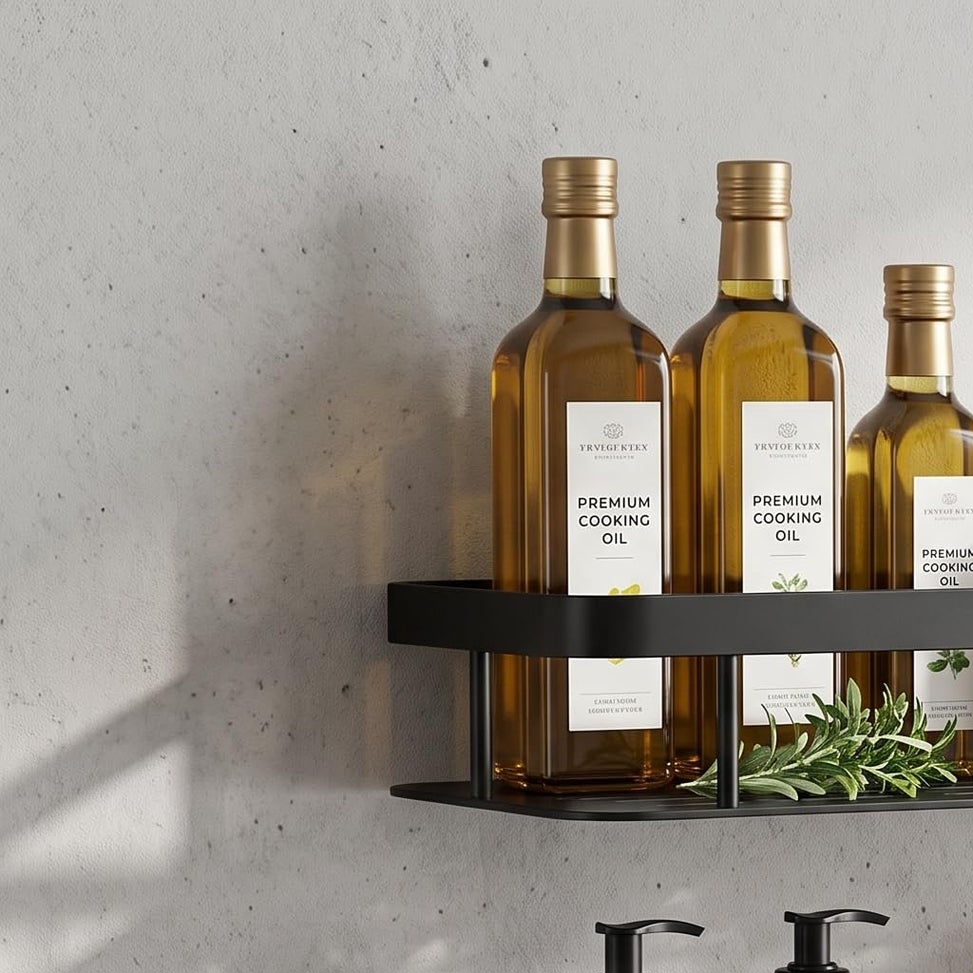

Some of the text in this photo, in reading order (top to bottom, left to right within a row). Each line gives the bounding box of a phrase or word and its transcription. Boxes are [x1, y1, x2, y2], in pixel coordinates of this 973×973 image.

[578, 496, 650, 509] PREMIUM
[753, 495, 822, 507] PREMIUM
[578, 514, 650, 527] COOKING
[753, 511, 822, 525] COOKING
[602, 532, 628, 545] OIL
[775, 529, 800, 542] OIL
[939, 576, 959, 586] OIL
